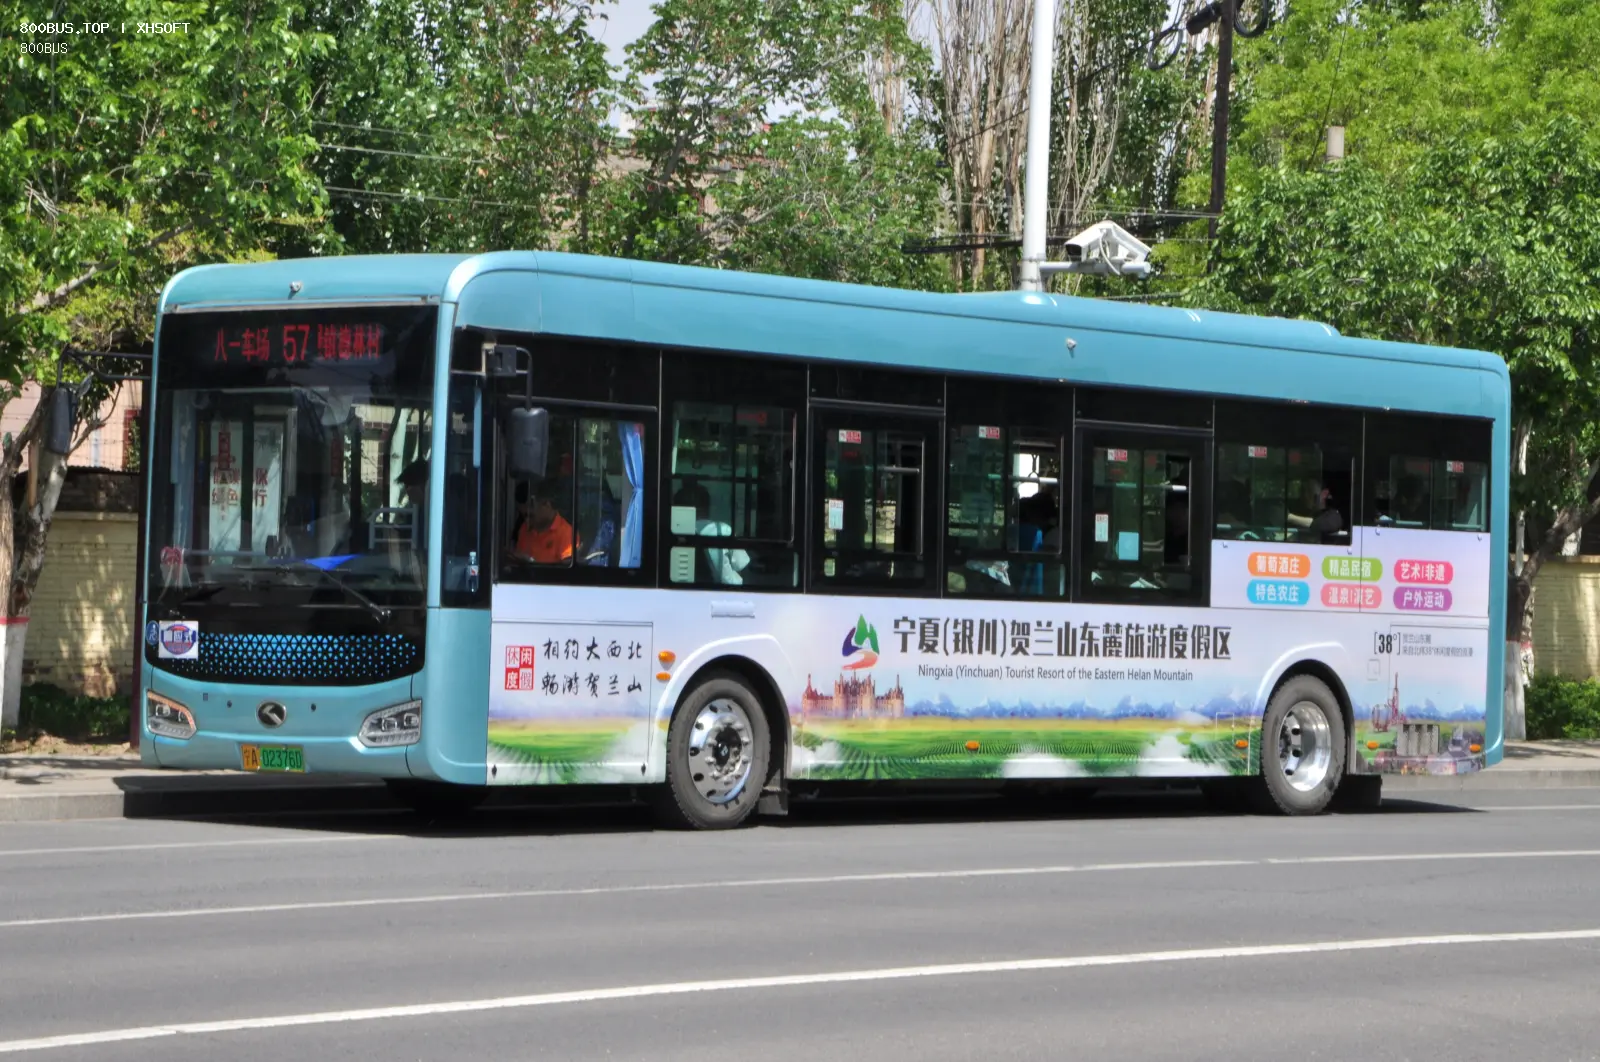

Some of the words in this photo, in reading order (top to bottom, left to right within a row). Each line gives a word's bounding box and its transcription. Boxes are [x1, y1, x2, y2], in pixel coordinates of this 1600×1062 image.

[283, 325, 311, 361] 57
[1255, 583, 1300, 603] 特色农庄
[1403, 590, 1445, 609] 户外运动
[542, 636, 642, 661] 相约大西北
[918, 665, 953, 680] Ningxia
[955, 665, 1003, 680] (Yinchuan)
[1006, 666, 1034, 679] Tourist
[1037, 666, 1065, 679] Resort
[1067, 667, 1076, 680] of
[1078, 667, 1092, 680] the
[1094, 668, 1125, 680] Eastern
[1127, 669, 1151, 681] Helan
[1154, 669, 1193, 681] Mountain
